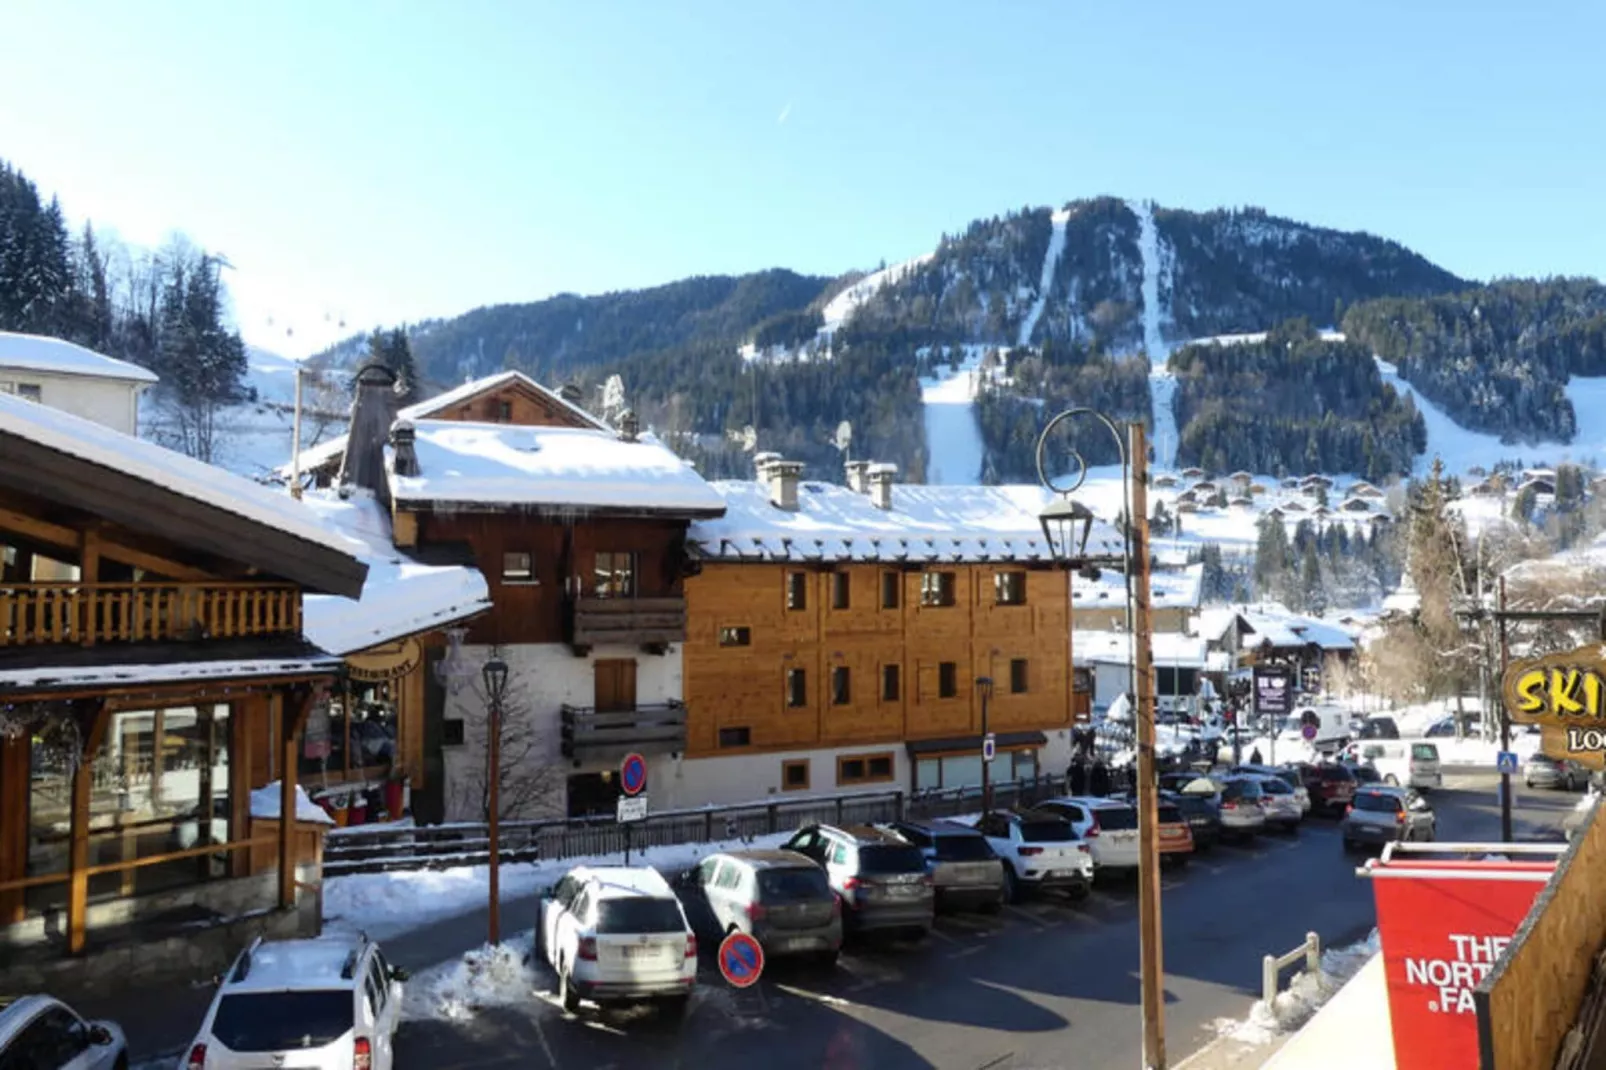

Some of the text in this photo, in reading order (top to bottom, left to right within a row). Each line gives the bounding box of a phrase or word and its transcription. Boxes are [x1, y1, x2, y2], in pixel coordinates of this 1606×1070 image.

[1516, 668, 1600, 716] SKI
[1568, 729, 1606, 751] LO
[1448, 934, 1511, 962] THE
[1405, 958, 1494, 989] NORT
[1440, 986, 1477, 1014] FA
